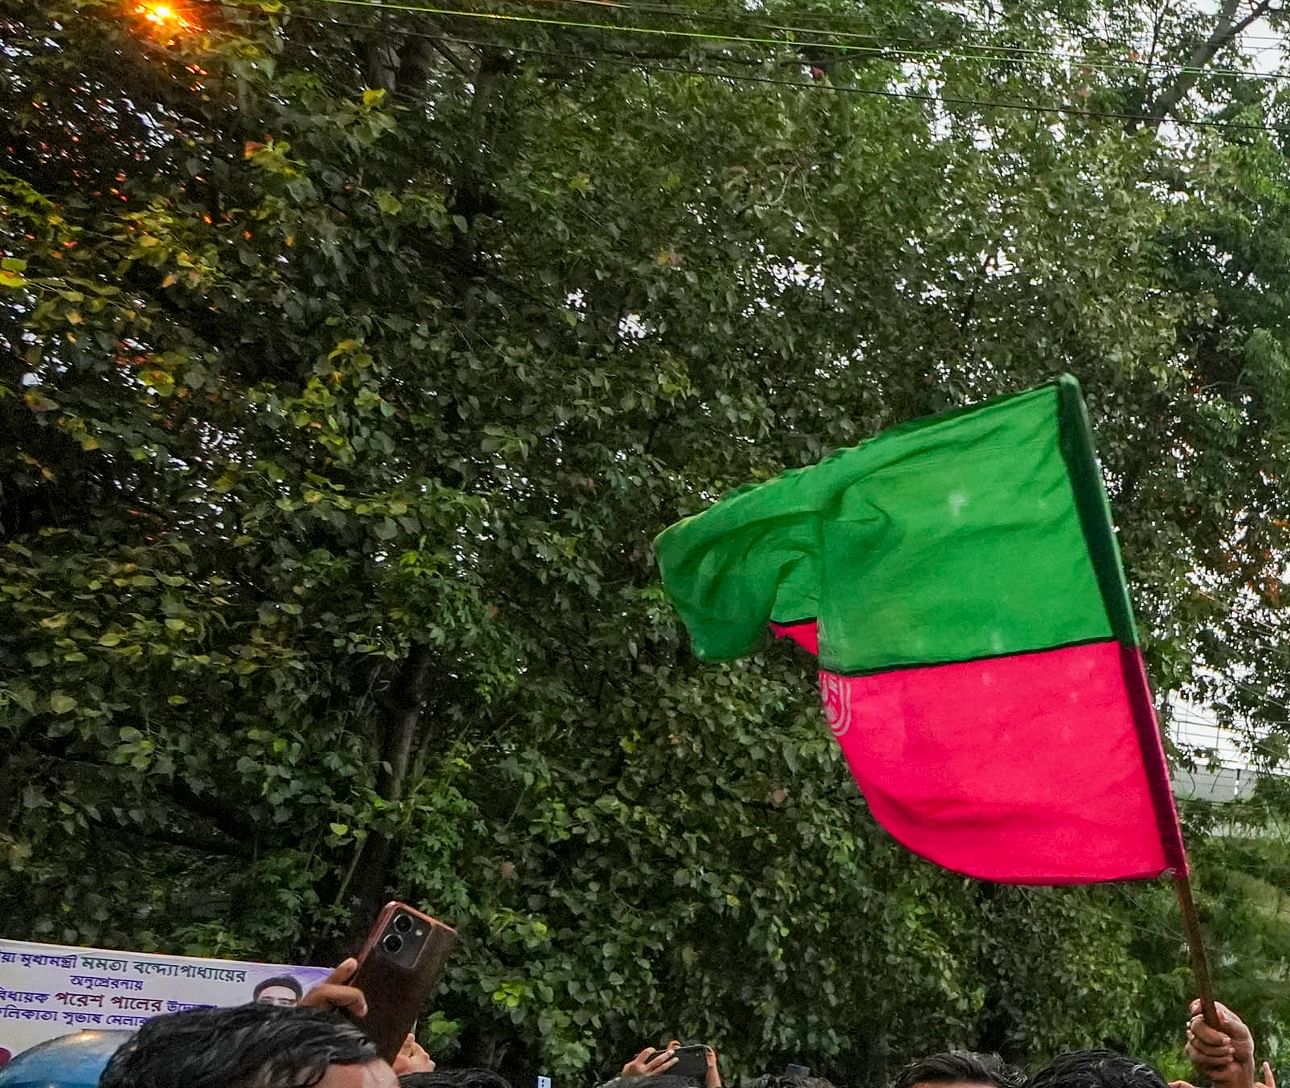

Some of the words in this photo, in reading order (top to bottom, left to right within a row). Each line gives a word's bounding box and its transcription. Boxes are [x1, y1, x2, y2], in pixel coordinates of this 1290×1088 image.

[81, 956, 128, 973] মমতা
[132, 960, 248, 983] বন্দ্যোপাধ্যায়ের
[54, 991, 106, 1008] পরেশ
[110, 996, 164, 1012] পালের
[62, 1011, 103, 1026] সুভাষ
